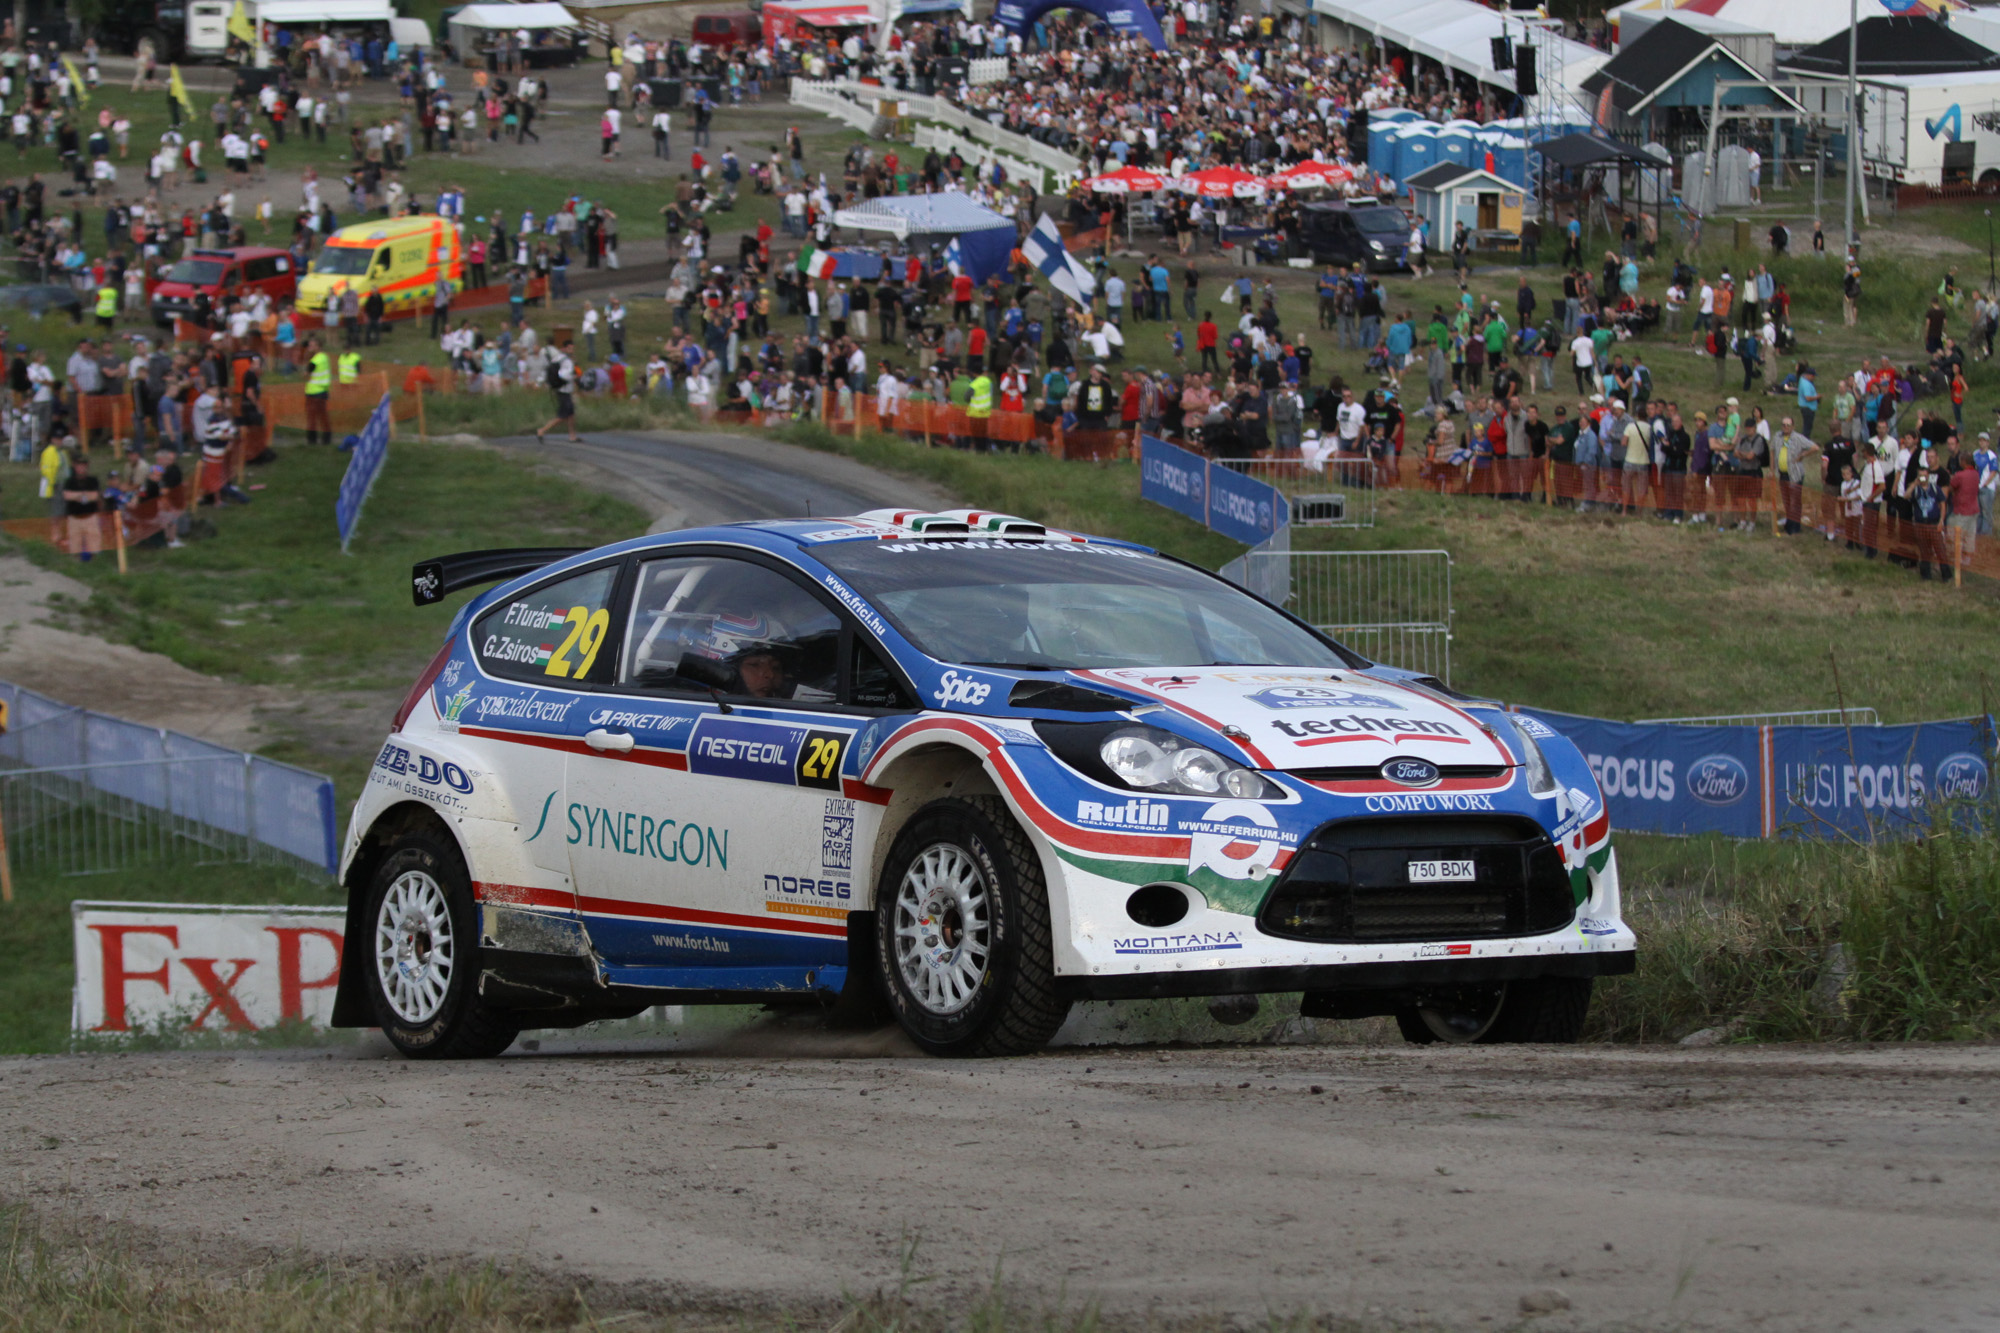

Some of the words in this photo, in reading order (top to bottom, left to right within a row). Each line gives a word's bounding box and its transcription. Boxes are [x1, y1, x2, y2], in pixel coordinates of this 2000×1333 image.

[1162, 462, 1188, 495] FOCUS
[1229, 493, 1255, 526] FOCUS
[504, 602, 553, 629] F.Turán
[825, 574, 887, 637] www.frici.hu
[482, 634, 540, 664] G.Zsiros
[544, 606, 610, 680] 29
[934, 670, 991, 707] Spice
[1282, 687, 1333, 698] 29
[611, 711, 660, 730] PAKET
[1271, 714, 1463, 737] techem
[375, 743, 474, 795] HE-DO
[803, 738, 840, 779] 29
[1396, 762, 1428, 779] Ford
[1587, 754, 1676, 801] FOCUS
[1700, 763, 1737, 797] Ford
[1785, 763, 1839, 807] UUSI
[1844, 763, 1925, 808] FOCUS
[1944, 761, 1981, 797] Ford
[825, 798, 856, 816] EXTREME
[1077, 799, 1169, 826] Rutin
[1365, 795, 1495, 812] COMPUWORX
[566, 802, 729, 871] SYNERGON
[1178, 820, 1298, 843] WWW.FEFERRUM.HU
[1411, 863, 1436, 878] 750
[1441, 862, 1472, 877] BDK
[764, 874, 851, 899] NOREG
[652, 932, 730, 953] www.ford.hu
[1114, 931, 1239, 948] MONTANA
